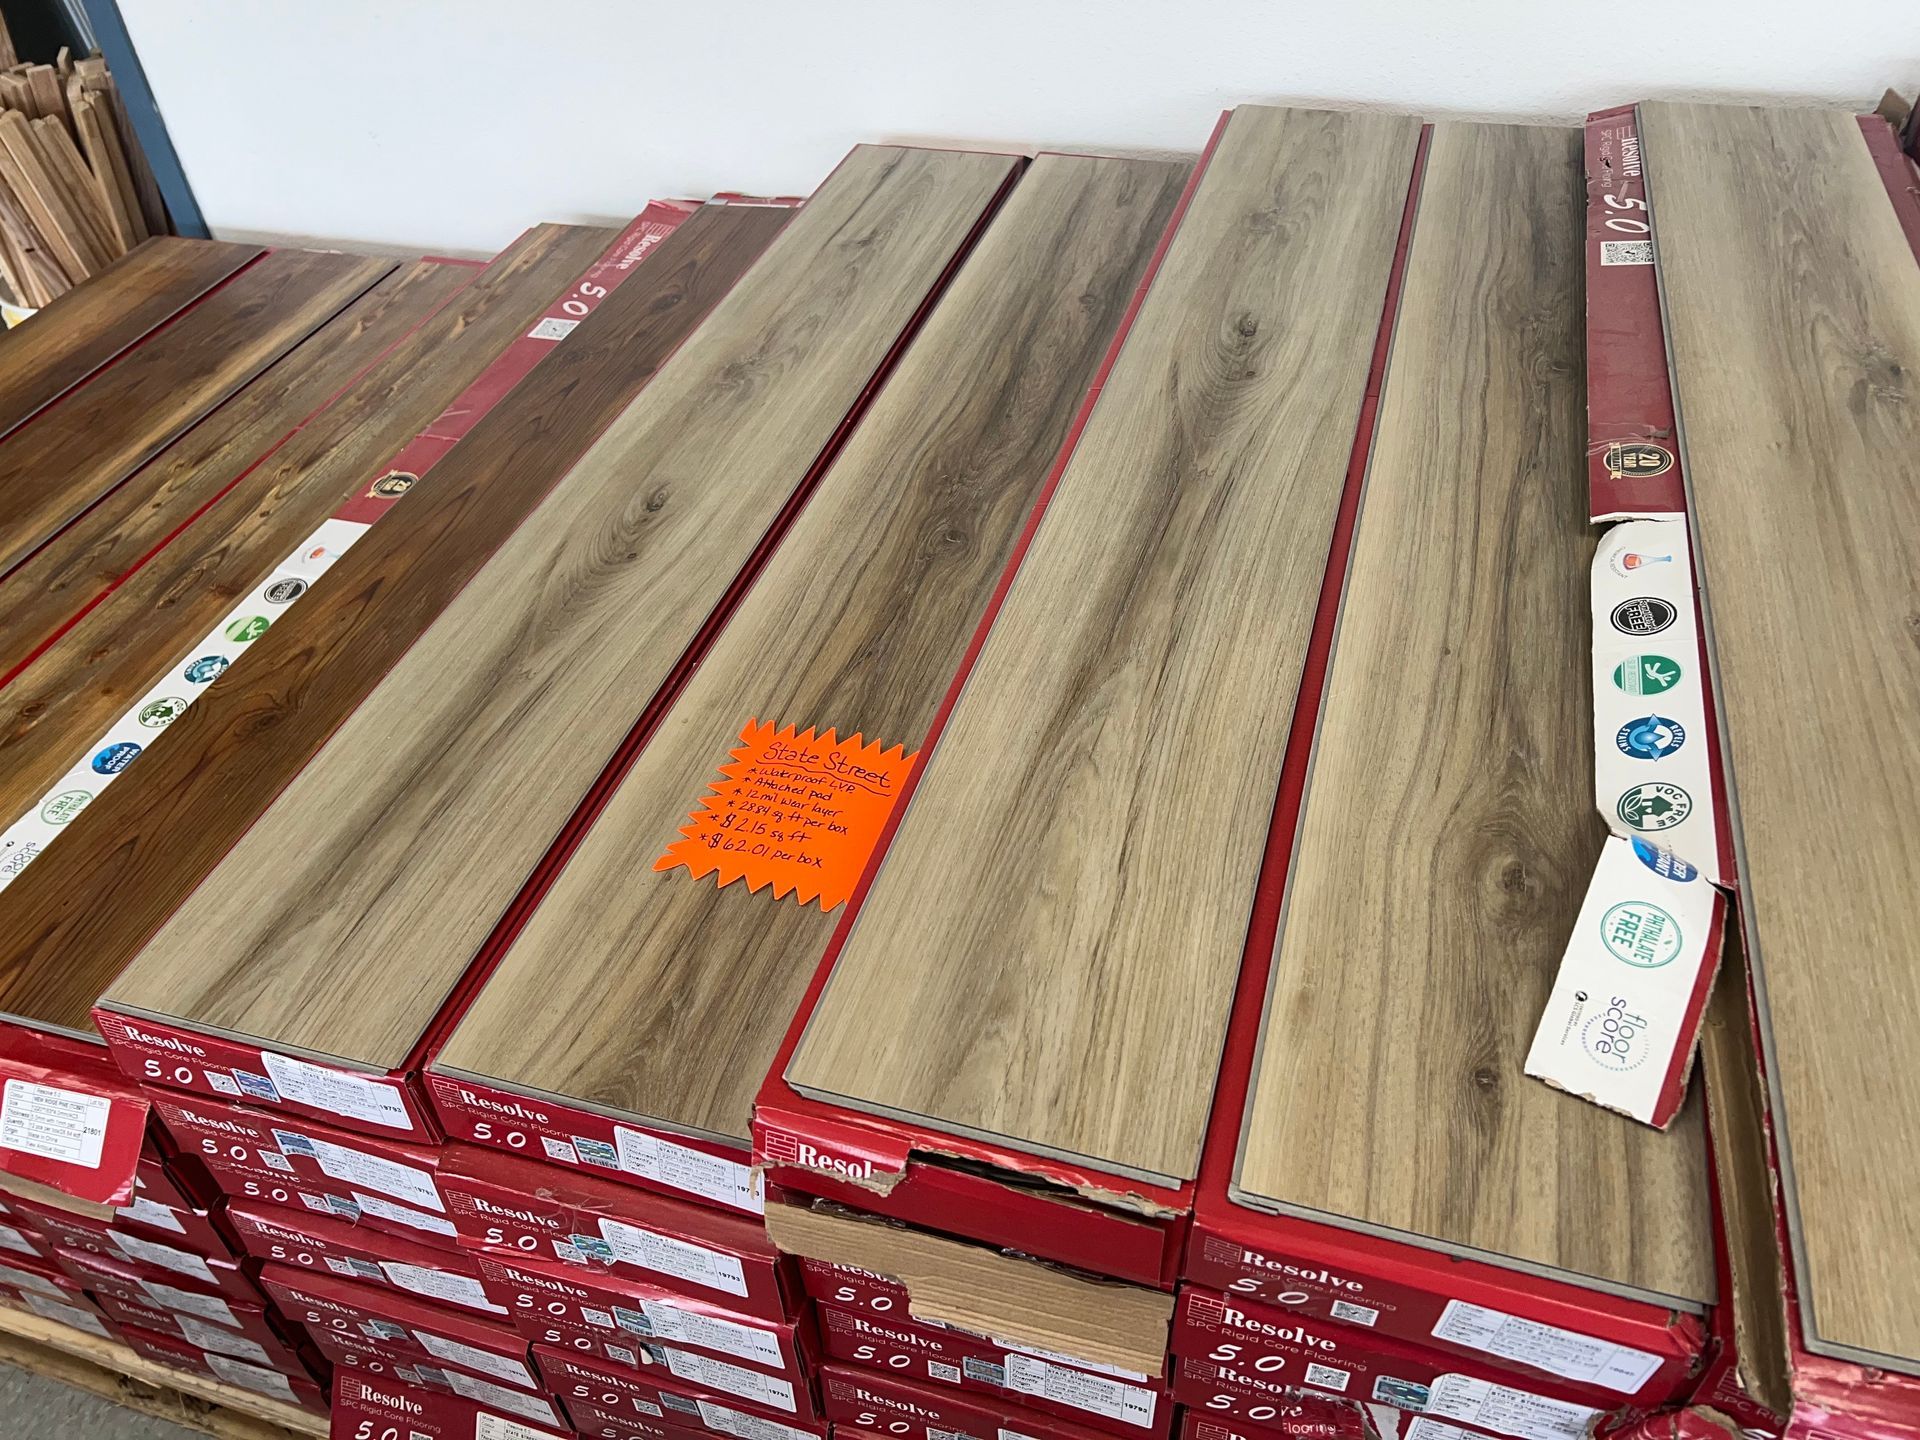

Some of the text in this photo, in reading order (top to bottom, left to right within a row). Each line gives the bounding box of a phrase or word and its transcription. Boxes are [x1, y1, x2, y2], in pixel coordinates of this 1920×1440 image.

[1621, 137, 1640, 177] Resolve
[1604, 194, 1649, 233] 5.0
[616, 235, 661, 269] Resolve
[562, 282, 607, 315] 5.0
[1623, 452, 1637, 468] YEAR
[1638, 453, 1661, 467] 20
[1625, 604, 1646, 631] FREE
[1619, 727, 1631, 752] STAINS
[1670, 724, 1684, 748] REPELS
[105, 746, 130, 770] PROOF
[112, 748, 140, 773] WATER
[763, 742, 891, 788] State Street
[754, 778, 832, 800] Attached pad
[760, 768, 828, 786] Waterproof
[47, 795, 73, 816] FREE
[739, 801, 770, 816] 28.84
[788, 812, 803, 821] ft
[803, 817, 824, 827] per
[828, 821, 848, 835] box
[781, 798, 809, 809] wear
[812, 803, 843, 817] layer
[1655, 785, 1687, 828] VOC FREE
[770, 830, 784, 842] sq
[788, 831, 812, 843] ft
[2, 842, 36, 873] score
[771, 849, 795, 860] per
[797, 852, 822, 868] box
[1612, 910, 1642, 949] FREE
[1633, 912, 1665, 963] PHTHALATE
[1595, 996, 1627, 1055] score
[110, 1036, 188, 1063] SPC Rigid Core
[124, 1025, 207, 1058] Resolve
[1612, 1013, 1648, 1064] floor
[144, 1059, 193, 1084] 5.0
[380, 1104, 402, 1113] 19793
[441, 1100, 528, 1128] SPC Rigid Core
[459, 1089, 550, 1125] Resolve
[83, 1126, 101, 1136] 21801
[169, 1118, 188, 1130] SPC
[181, 1110, 260, 1139] Resolve
[473, 1123, 527, 1148] 5.0
[202, 1139, 248, 1160] 5.0
[798, 1143, 879, 1179] Resol
[244, 1182, 288, 1202] 5.0
[736, 1185, 760, 1196] 1973
[453, 1207, 540, 1234] SPC Rigid Core
[473, 1197, 560, 1229] Resolve
[254, 1221, 326, 1249] Resolve
[484, 1227, 538, 1251] 5.0
[271, 1245, 314, 1265] 5.0
[504, 1267, 588, 1298] Resolve
[718, 1270, 741, 1283] 19793
[806, 1264, 898, 1295] SPC Rigid Core
[1203, 1254, 1397, 1312] SPC Rigid Core Flooring
[1243, 1250, 1363, 1293] Resolve
[486, 1276, 569, 1302] SPC Rigid Core
[834, 1286, 893, 1311] 5.0
[1229, 1278, 1310, 1305] 5.0
[118, 1301, 171, 1325] Resolve
[290, 1290, 359, 1317] Resolve
[516, 1294, 567, 1315] 5.0
[306, 1311, 348, 1329] 5.0
[1222, 1307, 1337, 1351] Resolve
[331, 1334, 396, 1360] Resolve
[544, 1330, 592, 1350] 5.0
[828, 1325, 920, 1353] SPC Rigid Core
[853, 1318, 943, 1352] Resolve
[1186, 1318, 1367, 1372] SPC Rigid Core Flooring
[344, 1354, 384, 1372] 5.0
[755, 1345, 778, 1357] 19793
[853, 1344, 911, 1368] 5.0
[1208, 1344, 1286, 1372] 5.0
[565, 1362, 640, 1393] Resolve
[1012, 1368, 1044, 1381] Thickness
[1012, 1373, 1038, 1384] Quantity
[1012, 1378, 1031, 1387] Origin
[1047, 1369, 1067, 1378] STATE
[1183, 1371, 1251, 1396] SPC Rigid
[360, 1384, 423, 1416] Resolve
[572, 1385, 619, 1405] 5.0
[767, 1387, 790, 1400] 19793
[856, 1388, 941, 1420] Resolve
[1491, 1391, 1515, 1402] STATE
[1712, 1391, 1751, 1412] SPC
[340, 1399, 442, 1434] SPC Rigid Core Flooring
[832, 1394, 855, 1404] SPC
[857, 1401, 887, 1413] Rigid
[890, 1408, 917, 1421] Core
[1124, 1403, 1148, 1414] 19793
[1206, 1394, 1276, 1420] 5.0
[593, 1408, 665, 1437] Resolve
[855, 1412, 910, 1433] 5.0
